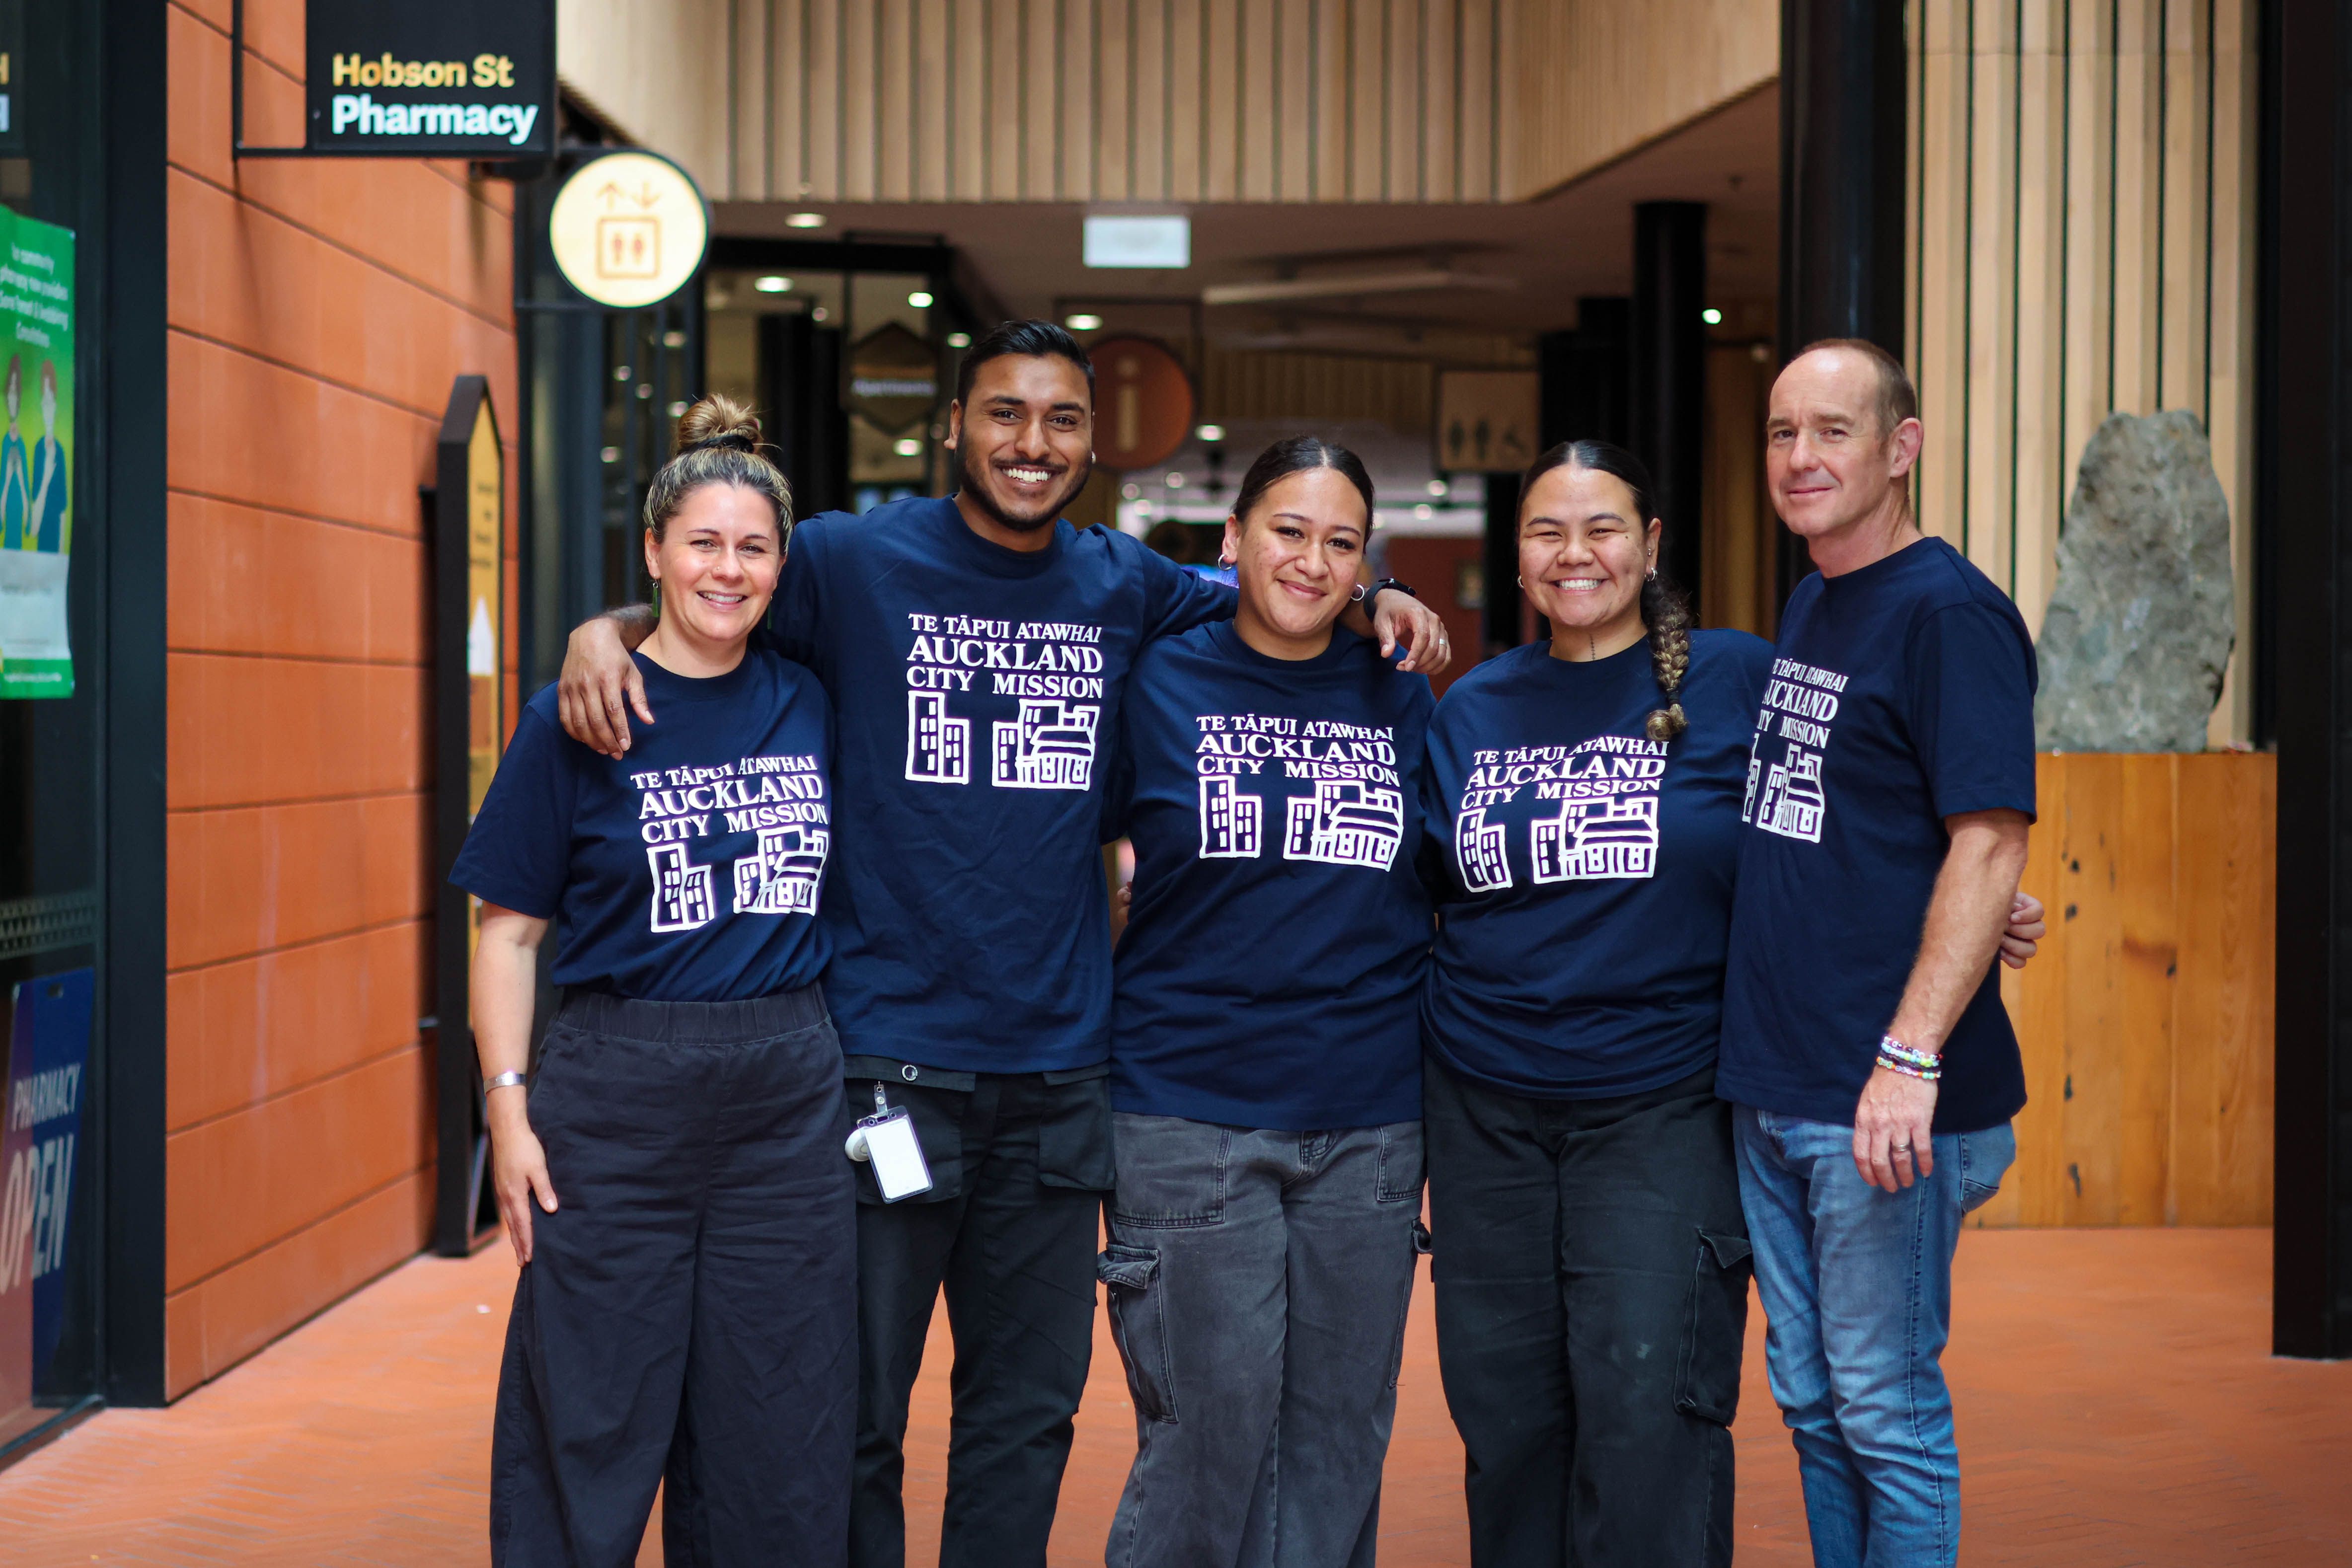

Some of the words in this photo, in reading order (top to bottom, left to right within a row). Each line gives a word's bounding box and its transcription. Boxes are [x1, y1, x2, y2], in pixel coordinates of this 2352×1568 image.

[332, 52, 467, 87] Hobson
[472, 53, 515, 88] St
[331, 92, 539, 146] Pharmacy
[908, 613, 938, 632] TE
[943, 615, 1010, 639] TĀPUI
[1015, 622, 1102, 643] ATAWHAI
[907, 635, 1103, 673] AUCKLAND
[906, 666, 975, 691] CITY
[992, 673, 1104, 699] MISSION
[1803, 666, 1849, 693] ATAWHAI
[1196, 716, 1226, 732] TE
[1231, 713, 1297, 736] TĀPUI
[1302, 721, 1394, 742] ATAWHAI
[1779, 716, 1831, 749] MISSION
[1196, 734, 1396, 765] AUCKLAND
[1473, 750, 1499, 765] TE
[1504, 747, 1568, 764] TĀPUI
[1569, 736, 1669, 756] ATAWHAI
[630, 772, 662, 789] TE
[665, 763, 735, 786] TĀPUI
[738, 755, 818, 775] ATAWHAI
[1197, 755, 1265, 775] CITY
[1284, 760, 1401, 787] MISSION
[1464, 755, 1666, 791] AUCKLAND
[638, 774, 823, 820] AUCKLAND
[1461, 787, 1521, 810] CITY
[1535, 778, 1663, 799] MISSION
[642, 815, 708, 843] CITY
[723, 802, 829, 834] MISSION
[12, 1063, 81, 1132] PHARMACY
[0, 1132, 75, 1294] OPEN
